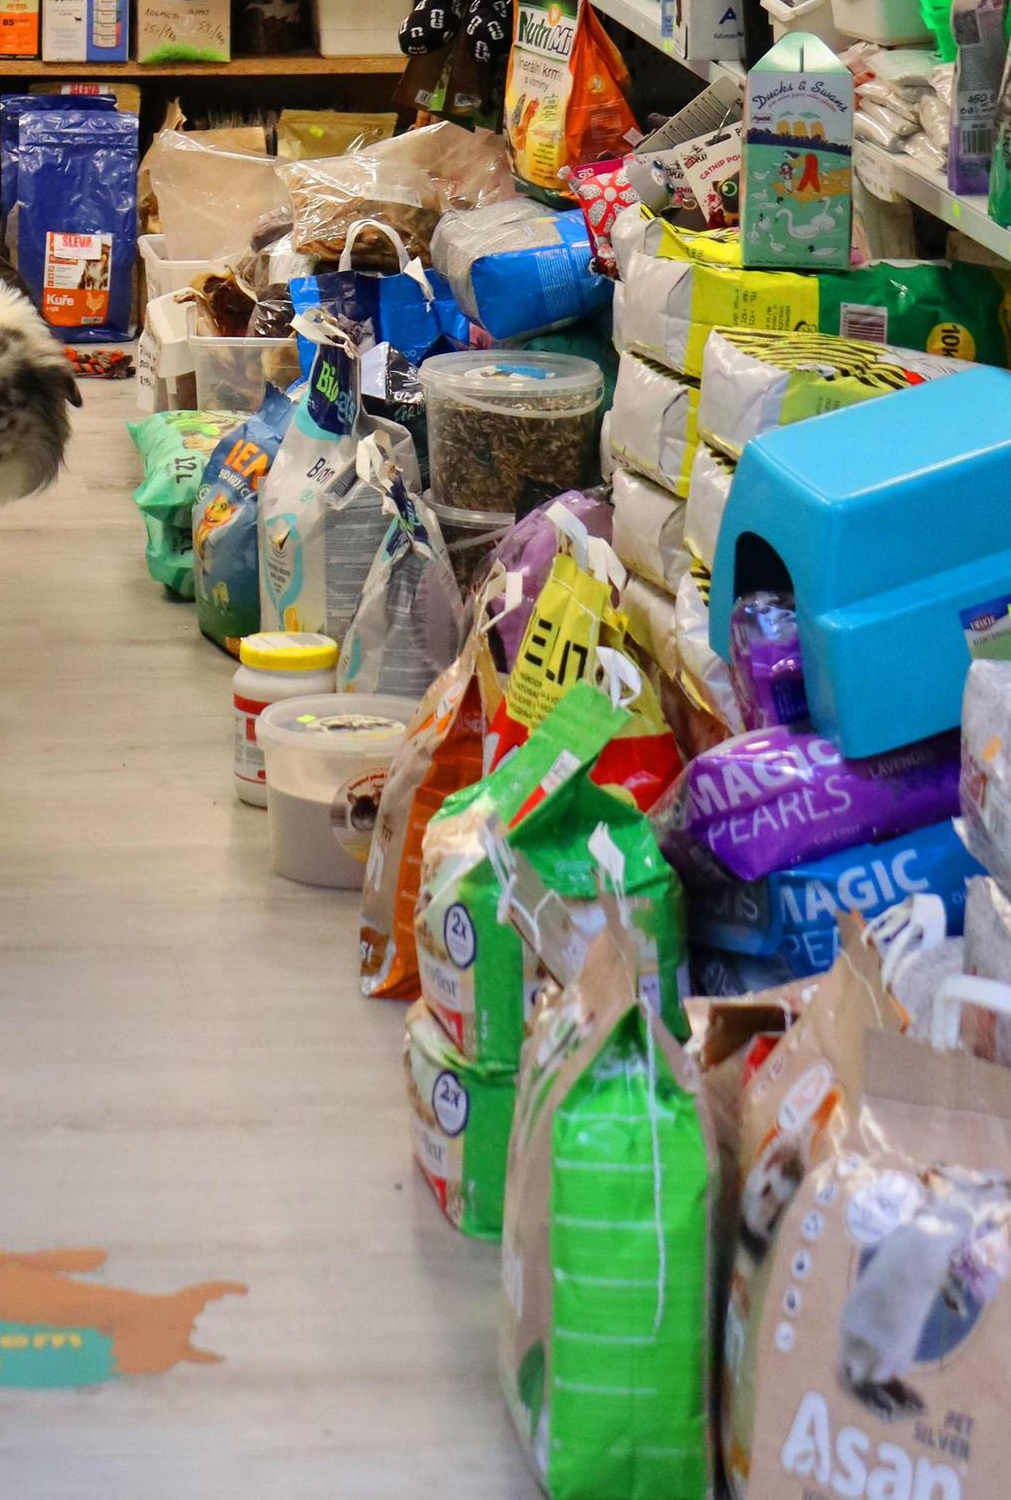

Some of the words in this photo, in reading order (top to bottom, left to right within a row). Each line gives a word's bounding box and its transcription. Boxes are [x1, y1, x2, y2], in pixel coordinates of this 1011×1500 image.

[2, 18, 15, 27] 85
[70, 84, 100, 95] SLEVA
[752, 80, 794, 111] Ducks
[797, 80, 807, 91] &
[810, 81, 850, 114] Swans
[699, 159, 726, 181] CATNIP
[63, 234, 93, 248] SLEVA
[46, 293, 74, 307] Kuře
[689, 738, 844, 820] MAGIC
[707, 774, 852, 851] PEARLS
[782, 848, 930, 924] MAGIC
[451, 910, 468, 941] 2x
[440, 1076, 461, 1108] 2x
[781, 1390, 964, 1500] Asan
